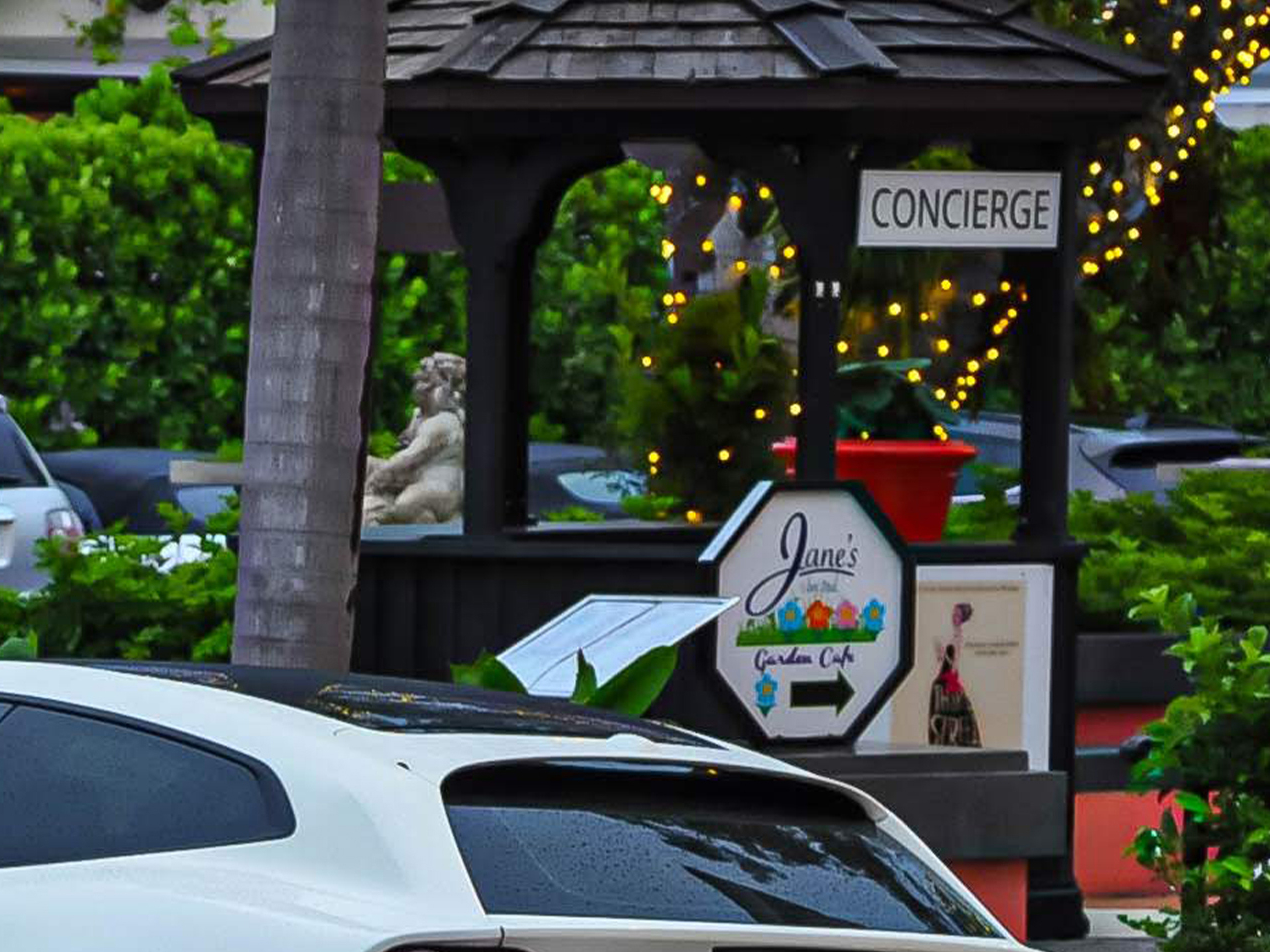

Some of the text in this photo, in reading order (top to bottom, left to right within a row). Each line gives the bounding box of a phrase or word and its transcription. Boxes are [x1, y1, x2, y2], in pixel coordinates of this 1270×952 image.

[871, 188, 1050, 230] CONCIERGE
[745, 512, 858, 616] Jane's
[754, 647, 812, 671] Garden
